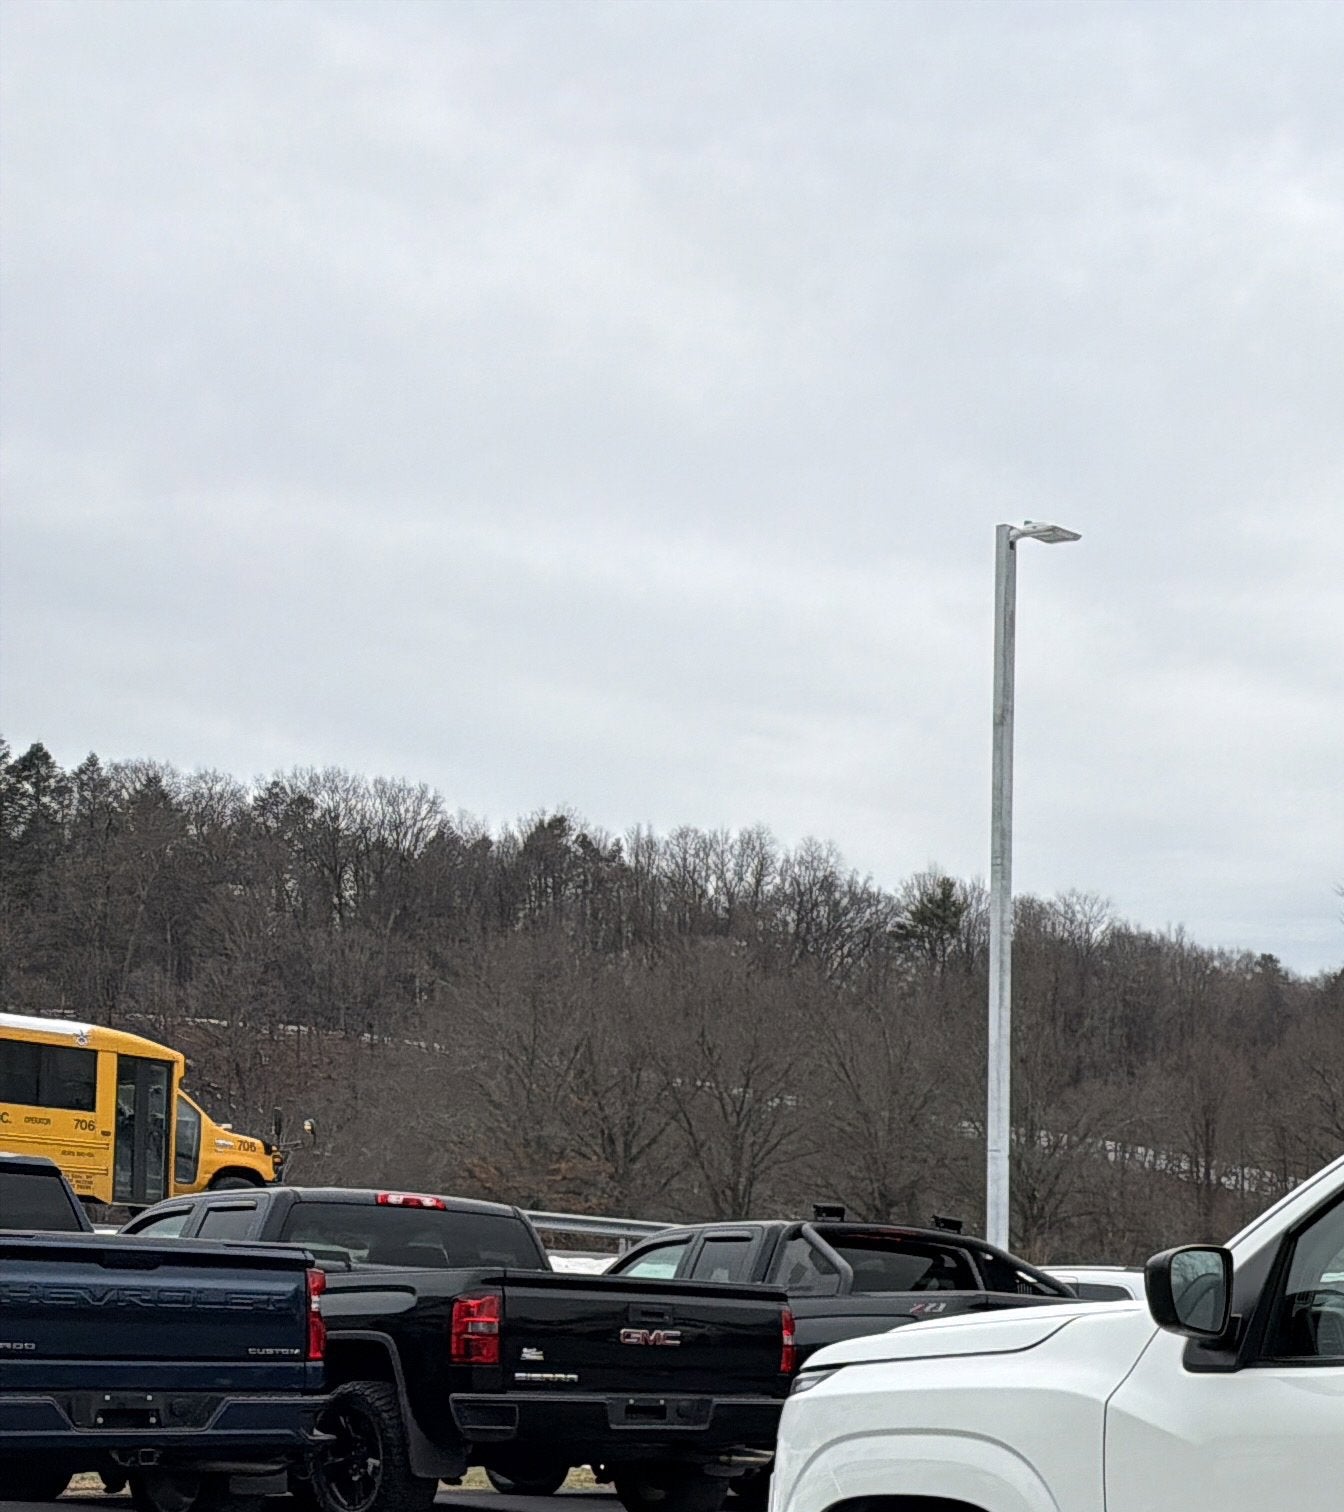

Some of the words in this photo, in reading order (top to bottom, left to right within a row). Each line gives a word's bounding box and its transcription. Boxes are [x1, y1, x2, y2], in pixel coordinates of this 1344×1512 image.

[74, 1118, 96, 1131] 706
[0, 1282, 287, 1311] HEVROLET
[619, 1328, 681, 1346] GMC
[248, 1347, 300, 1355] CUSTOM
[514, 1372, 579, 1383] SIERRA
